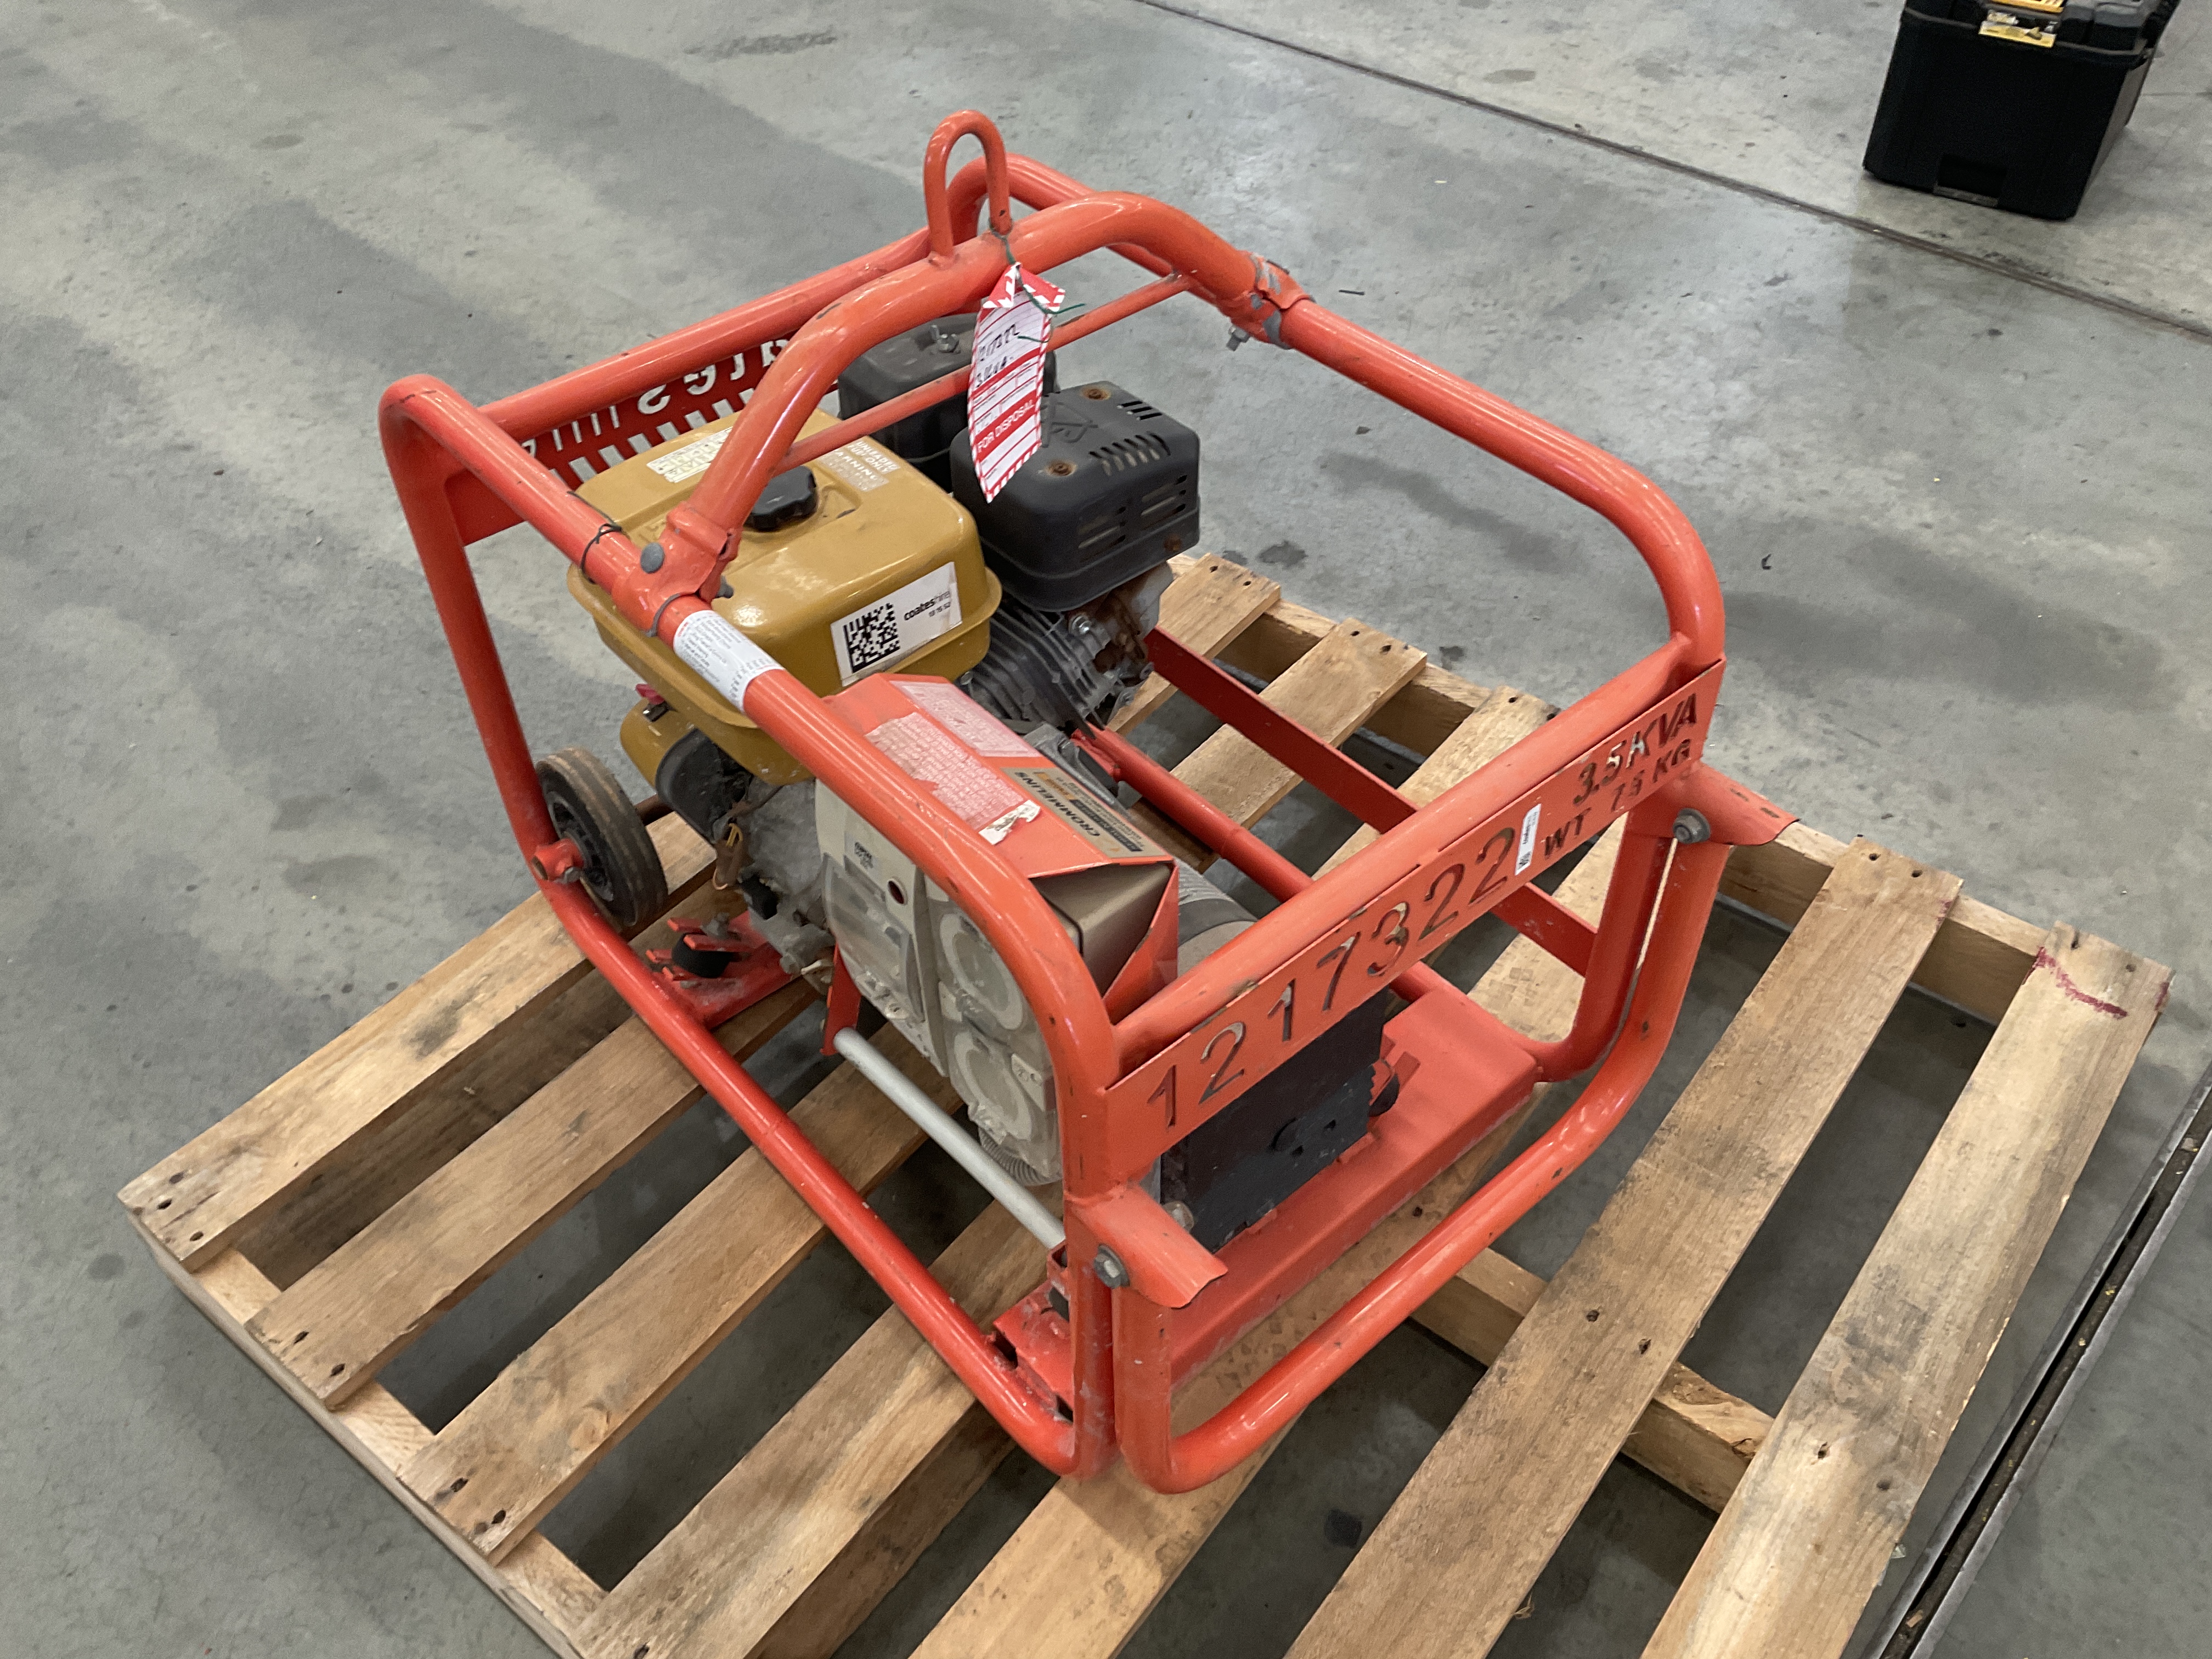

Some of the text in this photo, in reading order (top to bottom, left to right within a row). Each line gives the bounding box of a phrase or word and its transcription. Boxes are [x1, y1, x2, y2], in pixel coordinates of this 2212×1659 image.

[977, 399, 1035, 453] FOR DISPOSAL
[1015, 772, 1101, 836] CROMMELINS
[1544, 807, 1592, 860] WT
[1652, 738, 1691, 783] KG
[1147, 827, 1515, 1128] 1217322
